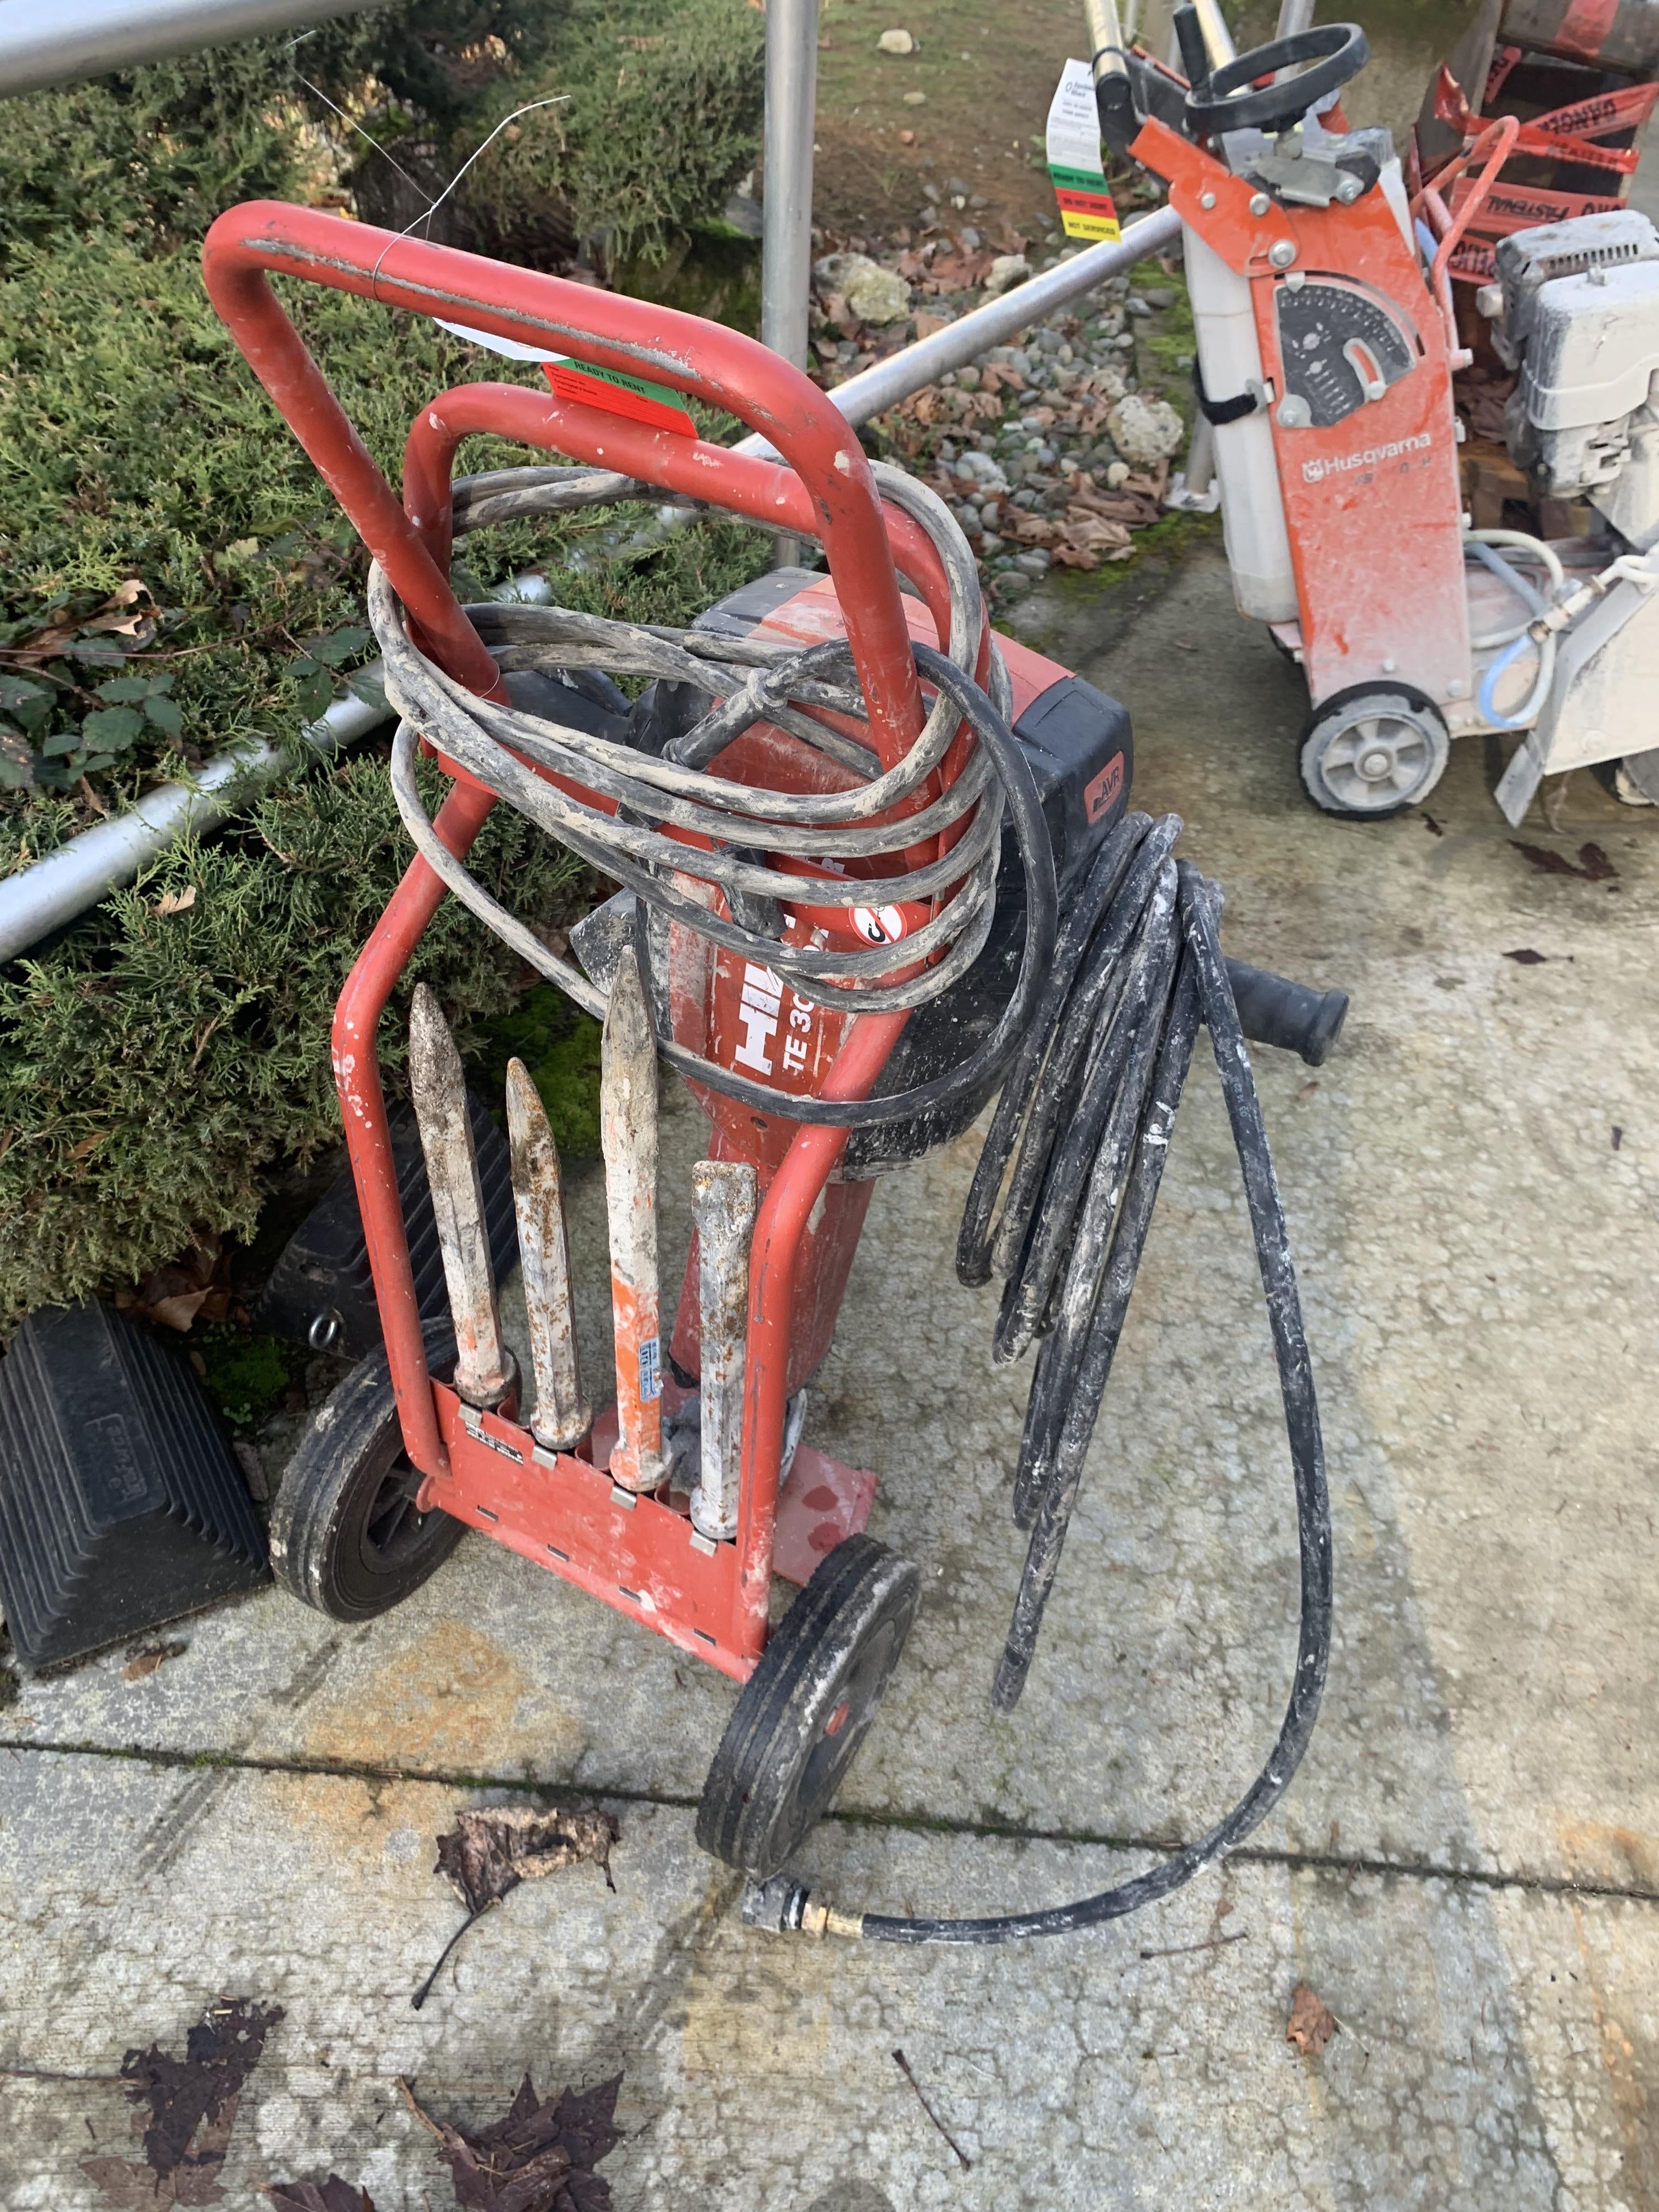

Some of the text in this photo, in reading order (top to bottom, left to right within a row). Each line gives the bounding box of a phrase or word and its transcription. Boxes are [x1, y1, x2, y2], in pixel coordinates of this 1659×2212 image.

[574, 362, 646, 394] READY TO RENT
[1324, 432, 1431, 475] Husqvarna
[1102, 766, 1119, 799] AVR
[783, 1034, 808, 1070] TE
